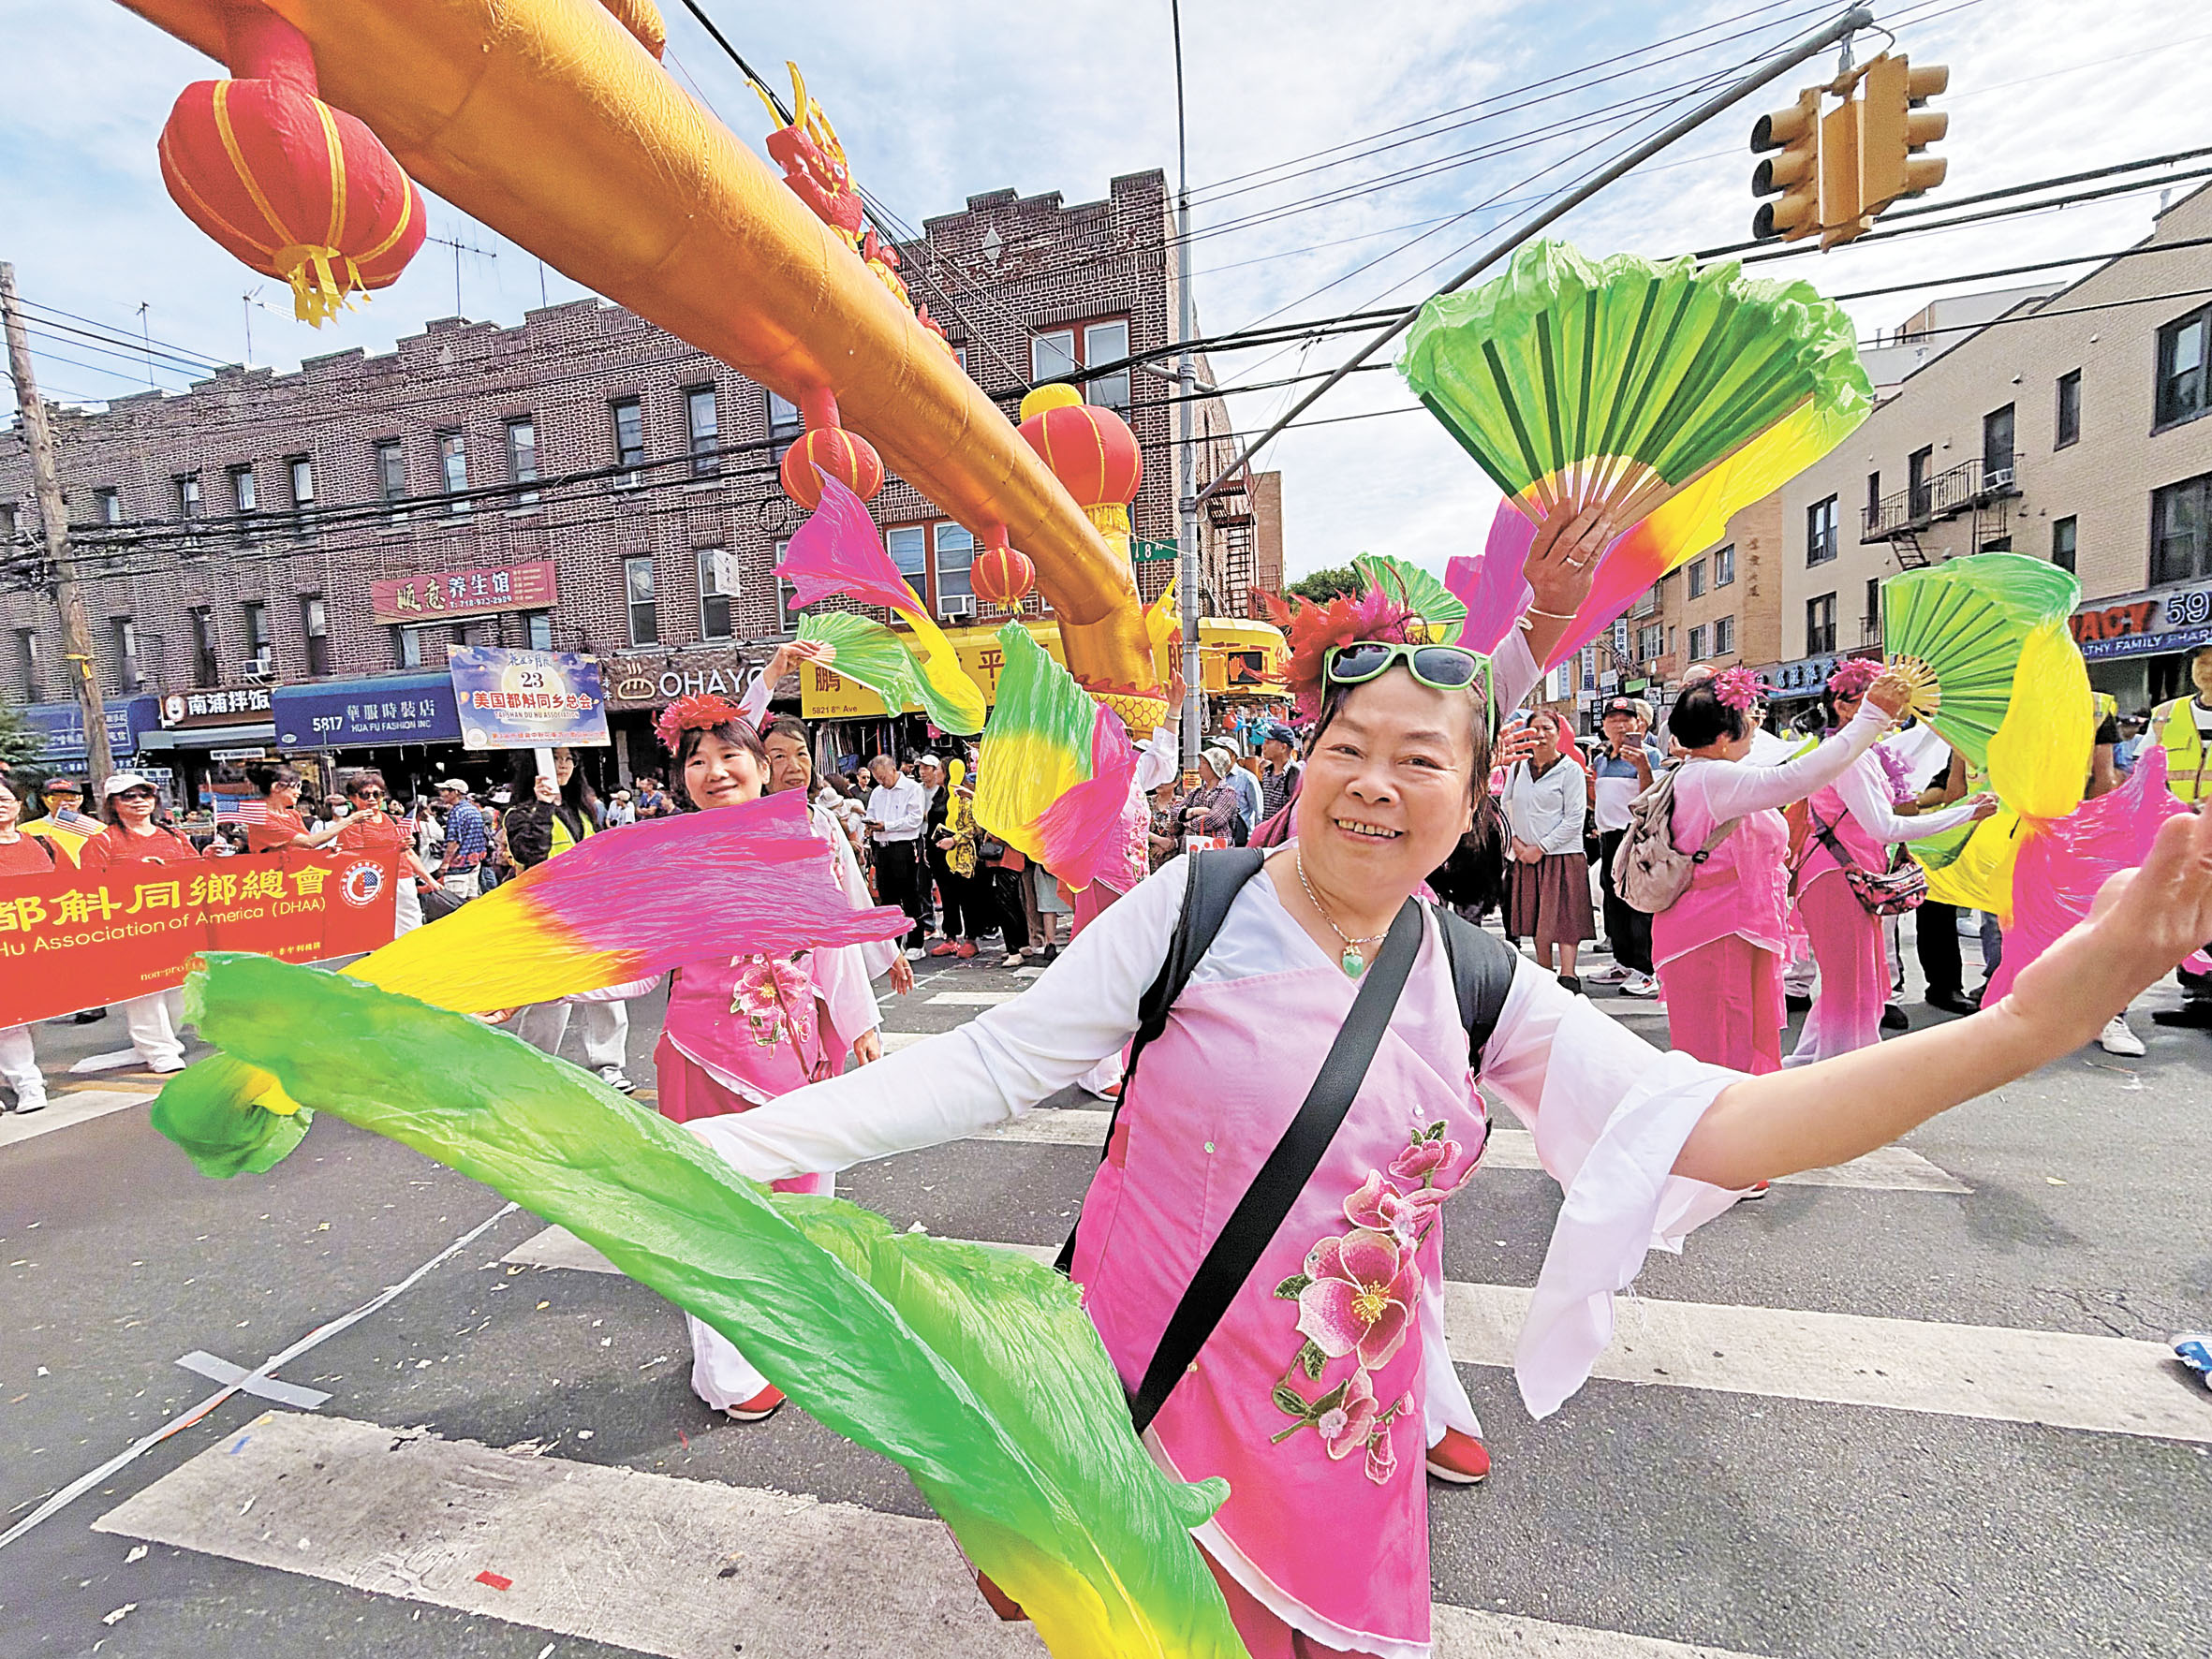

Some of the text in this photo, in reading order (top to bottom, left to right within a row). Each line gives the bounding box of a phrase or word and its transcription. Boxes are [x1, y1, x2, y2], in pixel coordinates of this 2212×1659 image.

[1144, 543, 1152, 559] 8
[2116, 635, 2163, 651] FAMILY
[521, 672, 544, 688] 23
[187, 689, 271, 715] 南浦拌饭
[474, 691, 593, 709] 美国都斛同乡总会
[812, 706, 830, 714] 5821
[843, 704, 858, 712] Ave
[312, 716, 343, 732] 5817
[351, 720, 432, 733] HUA FU FASHION INC
[34, 920, 166, 952] Association
[169, 913, 190, 929] of
[196, 907, 264, 926] America
[272, 898, 326, 918] (DHAA)
